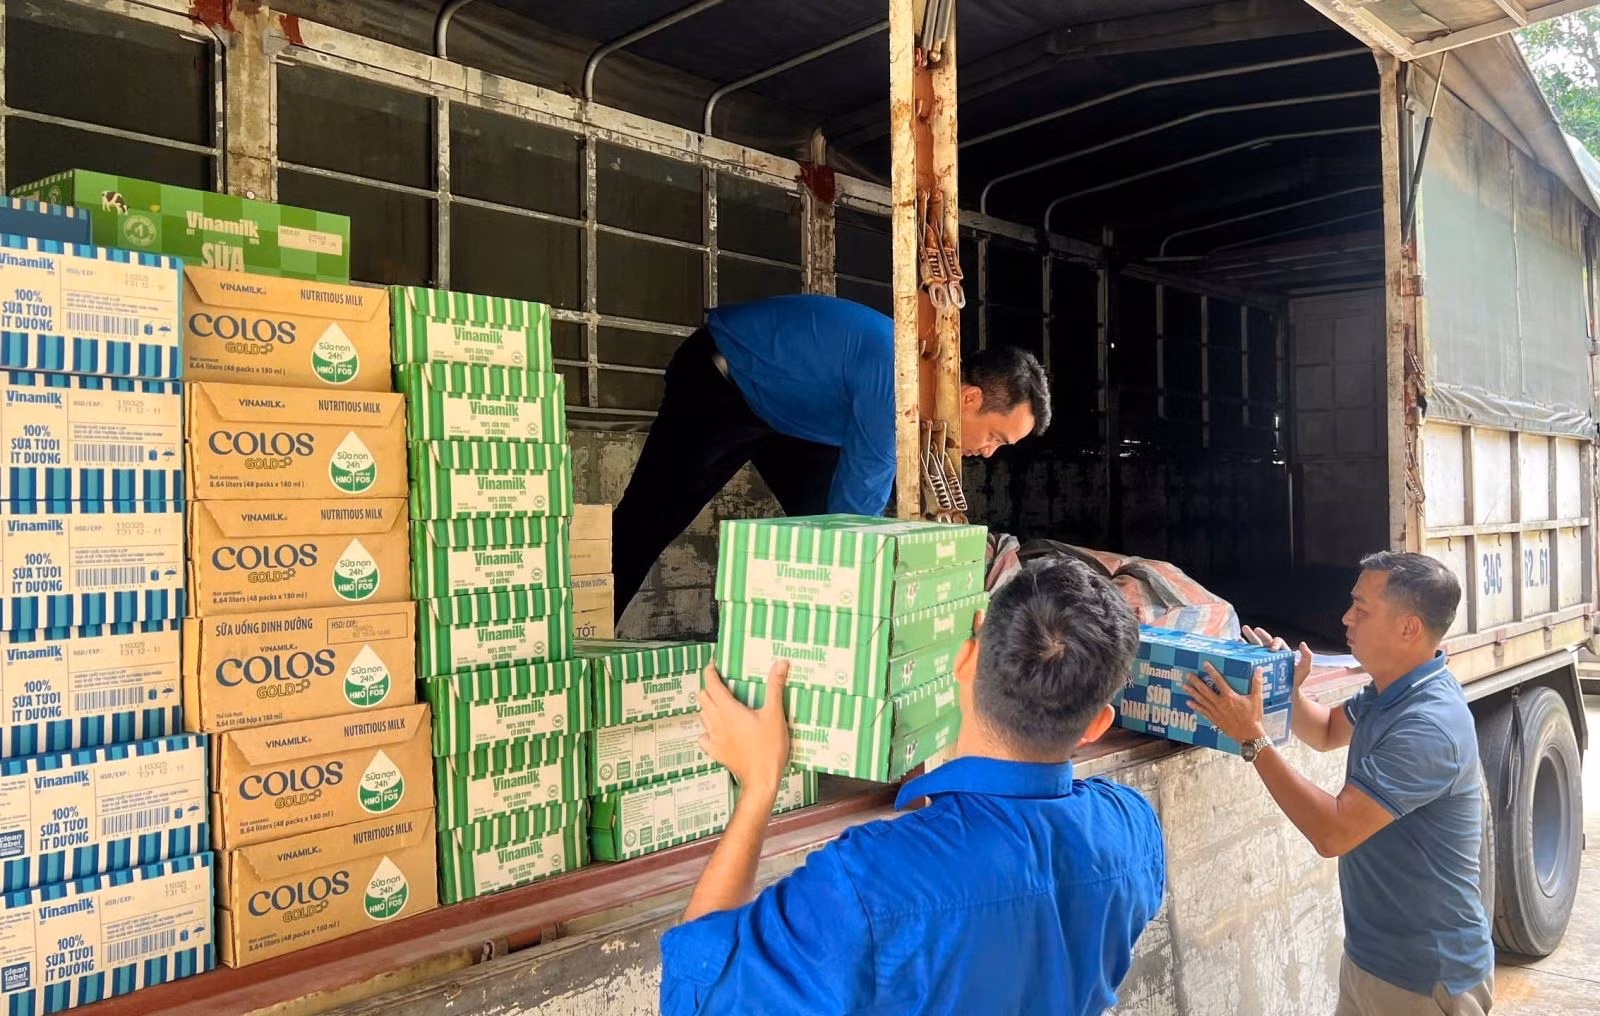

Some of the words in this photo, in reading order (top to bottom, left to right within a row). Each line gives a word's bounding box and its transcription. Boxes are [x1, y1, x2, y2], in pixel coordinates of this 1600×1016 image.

[186, 210, 260, 239] Vinamilk
[220, 282, 263, 295] VINAMILK
[15, 288, 43, 303] 100%
[300, 289, 344, 305] NUTRITIOUS
[345, 293, 363, 306] MILK
[189, 313, 297, 344] COLOS
[454, 326, 504, 344] Vinamilk
[225, 342, 261, 355] GOLD
[334, 344, 351, 352] non
[328, 351, 342, 360] 24h
[317, 366, 334, 375] HMO
[338, 367, 353, 376] FOS
[6, 390, 62, 405] Vinamilk
[239, 398, 281, 409] VINAMILK
[318, 399, 362, 413] NUTRITIOUS
[362, 402, 381, 413] MILK
[470, 401, 519, 417] Vinamilk
[23, 424, 51, 437] 100%
[208, 430, 314, 456] COLOS
[245, 457, 279, 469] GOLD
[346, 461, 360, 469] 24h
[335, 476, 352, 484] HMO
[356, 476, 371, 484] FOS
[477, 477, 527, 490] Vinamilk
[241, 513, 284, 522] VINAMILK
[321, 509, 364, 520] NUTRITIOUS
[365, 508, 383, 520] MILK
[7, 519, 64, 532] Vinamilk
[24, 553, 52, 566] 100%
[212, 543, 318, 571] COLOS
[474, 550, 524, 566] Vinamilk
[248, 570, 283, 583] GOLD
[349, 568, 363, 576] 24h
[775, 562, 831, 582] Vinamilk
[338, 583, 354, 592] HMO
[358, 582, 373, 591] FOS
[216, 622, 233, 637] SỮA
[235, 619, 259, 635] UỐNG
[261, 620, 282, 633] DINH
[477, 625, 526, 642] Vinamilk
[576, 621, 597, 637] TỐT
[7, 645, 62, 661] Vinamilk
[259, 643, 294, 653] VINAMILK
[772, 642, 827, 662] Vinamilk
[216, 649, 336, 687] COLOS
[367, 665, 382, 673] non
[1140, 661, 1183, 682] Vinamilk
[359, 674, 374, 683] 24h
[23, 679, 52, 693] 100%
[257, 684, 295, 699] GOLD
[642, 678, 682, 695] Vinamilk
[350, 690, 365, 699] HMO
[369, 689, 384, 697] FOS
[496, 699, 545, 718] Vinamilk
[344, 724, 387, 738] NUTRITIOUS
[387, 719, 405, 731] MILK
[790, 727, 829, 744] namilk
[265, 736, 308, 749] VINAMILK
[34, 770, 89, 790] Vinamilk
[239, 760, 344, 801] COLOS
[381, 770, 397, 779] non
[492, 769, 541, 792] Vinamilk
[375, 781, 388, 789] 24h
[275, 795, 309, 809] GOLD
[364, 797, 380, 806] HMO
[384, 793, 399, 802] FOS
[52, 806, 79, 821] 100%
[353, 827, 395, 845] NUTRITIOUS
[395, 821, 413, 836] MILK
[277, 846, 318, 862] VINAMILK
[497, 841, 543, 865] Vinamilk
[386, 874, 401, 884] non
[248, 870, 350, 917] COLOS
[379, 886, 393, 896] 24h
[39, 897, 94, 920] Vinamilk
[369, 904, 385, 914] HMO
[388, 898, 403, 908] FOS
[282, 904, 316, 923] GOLD
[57, 934, 85, 950] 100%
[4, 966, 27, 976] clean
[5, 973, 26, 981] label
